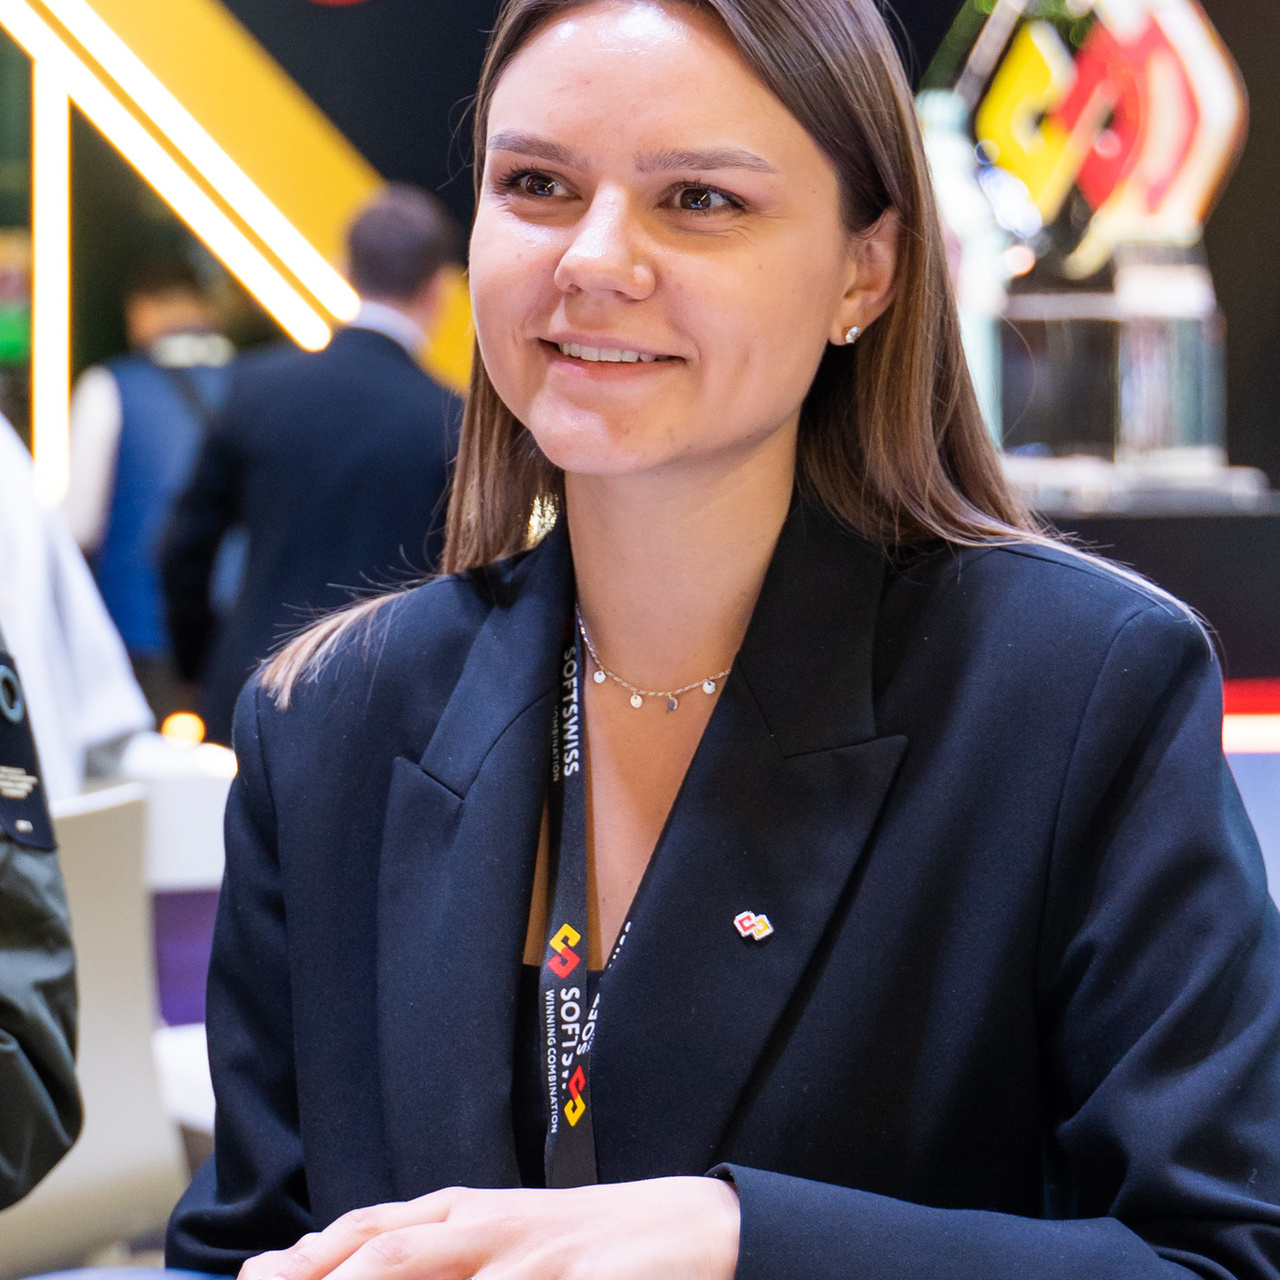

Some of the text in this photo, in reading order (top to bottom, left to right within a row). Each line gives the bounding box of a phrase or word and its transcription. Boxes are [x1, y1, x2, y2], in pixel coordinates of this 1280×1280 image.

[552, 704, 561, 782] OMBINATION
[562, 645, 580, 777] SOFTSWISS
[545, 989, 559, 1134] WINNING COMBINATION
